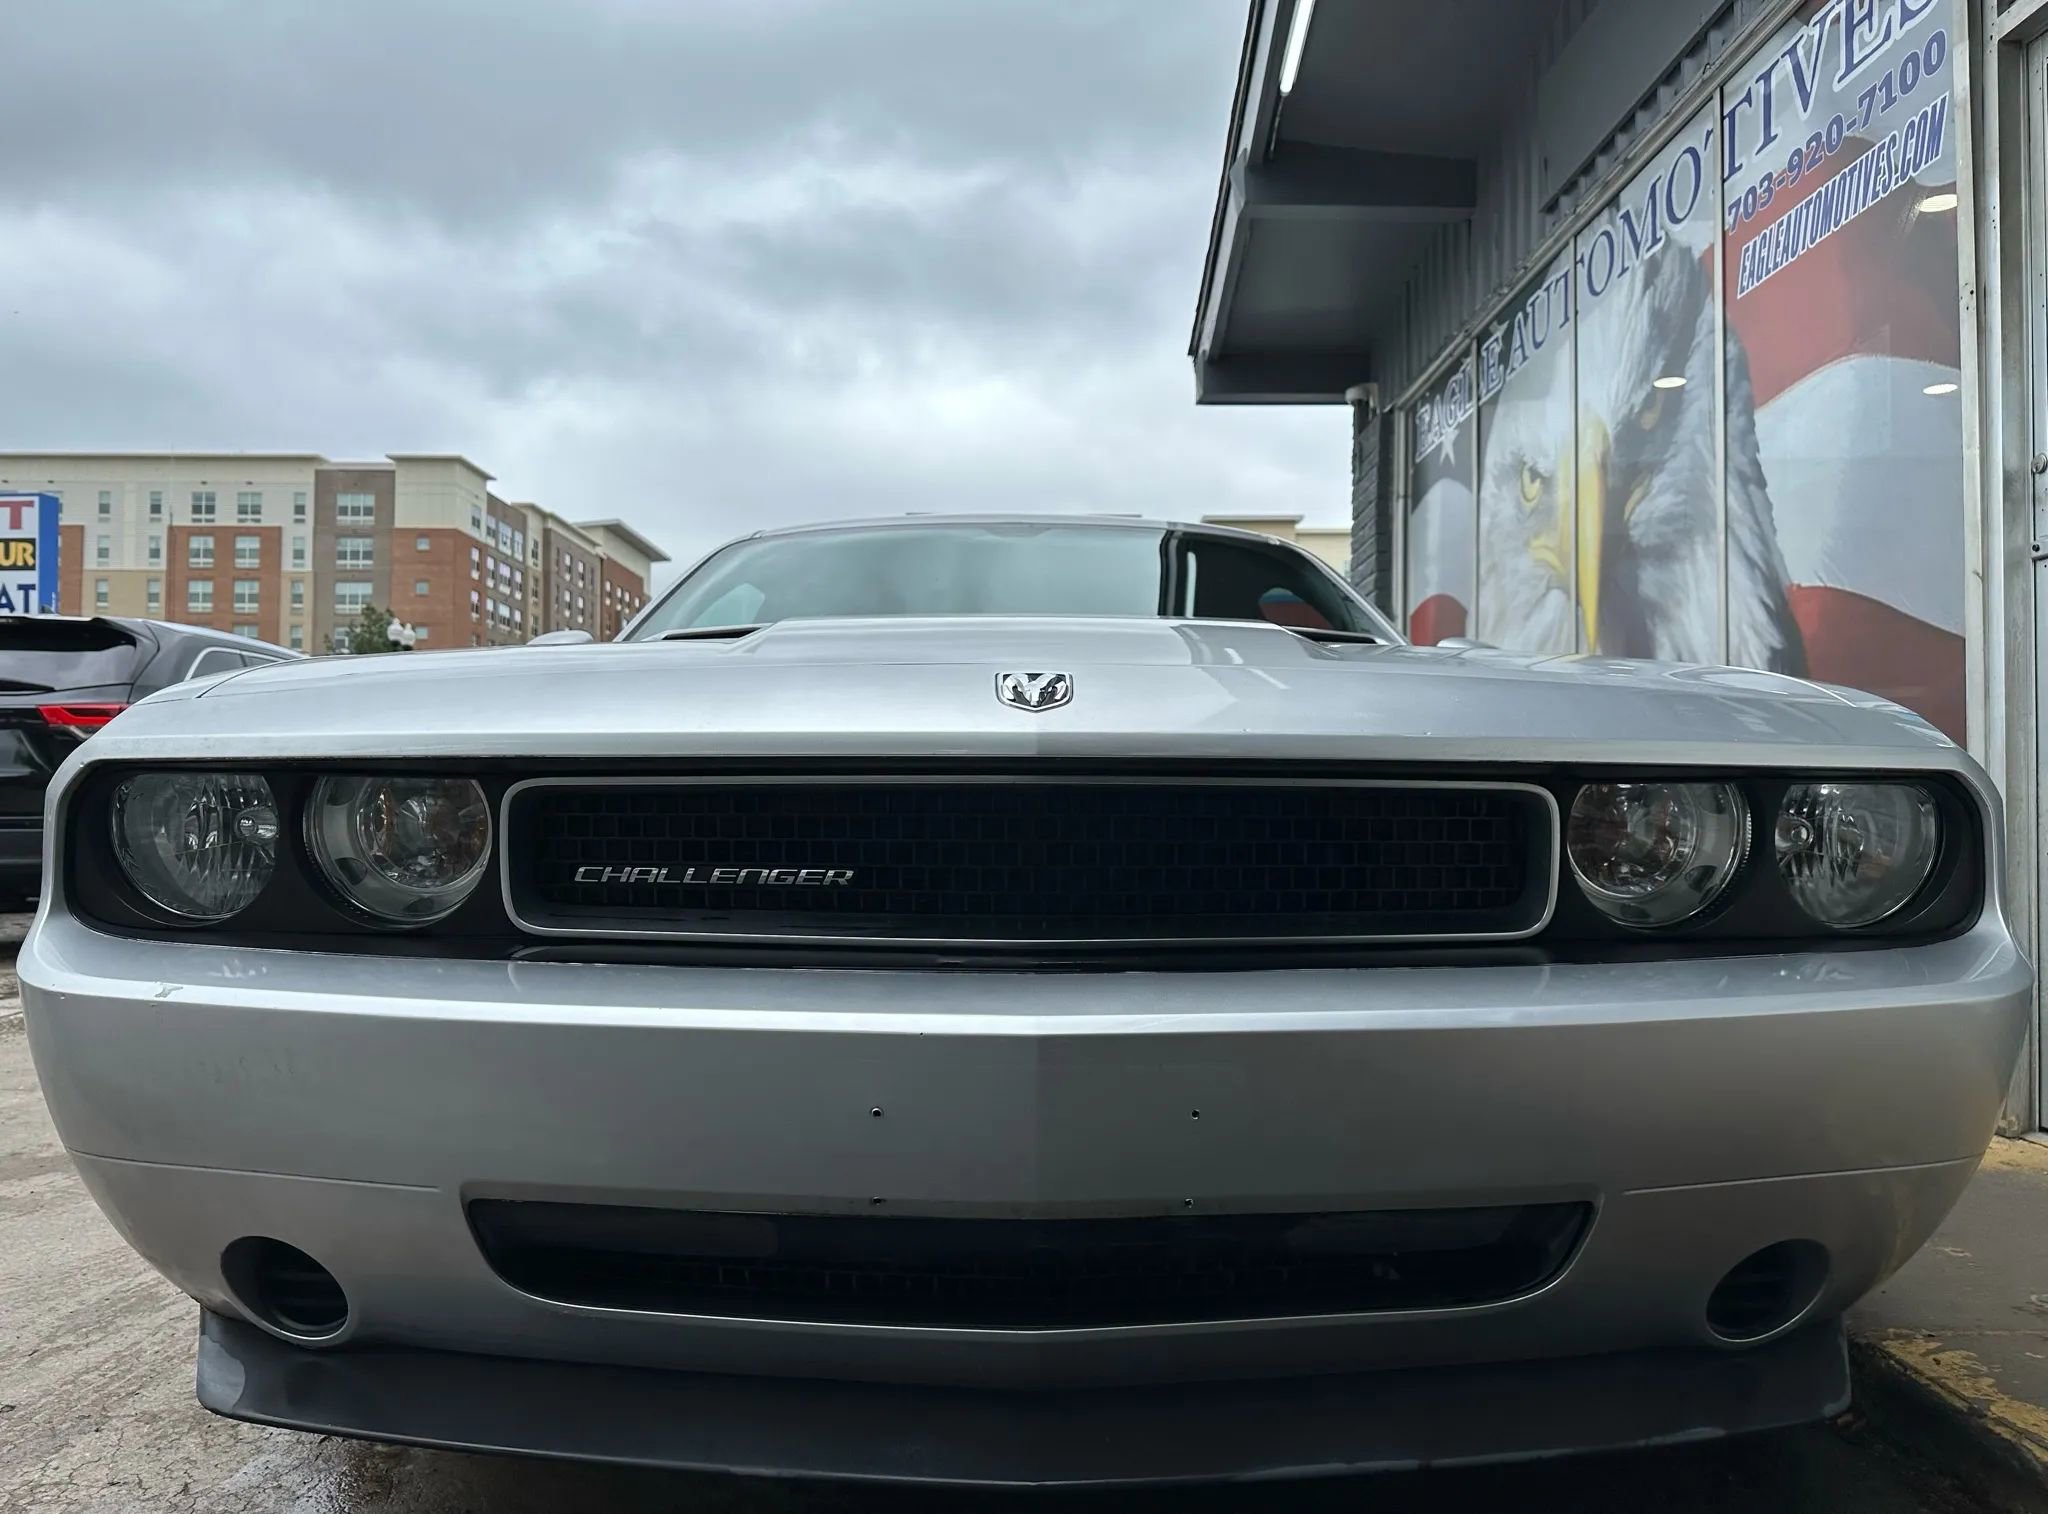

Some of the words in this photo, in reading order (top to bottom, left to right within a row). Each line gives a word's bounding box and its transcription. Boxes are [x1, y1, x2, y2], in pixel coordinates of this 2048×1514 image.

[1416, 333, 1505, 463] EAGLE
[1506, 0, 1936, 380] AUTOMOTIVE
[1728, 29, 1947, 235] 703-920-7100
[1737, 92, 1949, 299] EAGLEAUTOMOTIVES.COM
[574, 866, 854, 886] CHALLENGER
